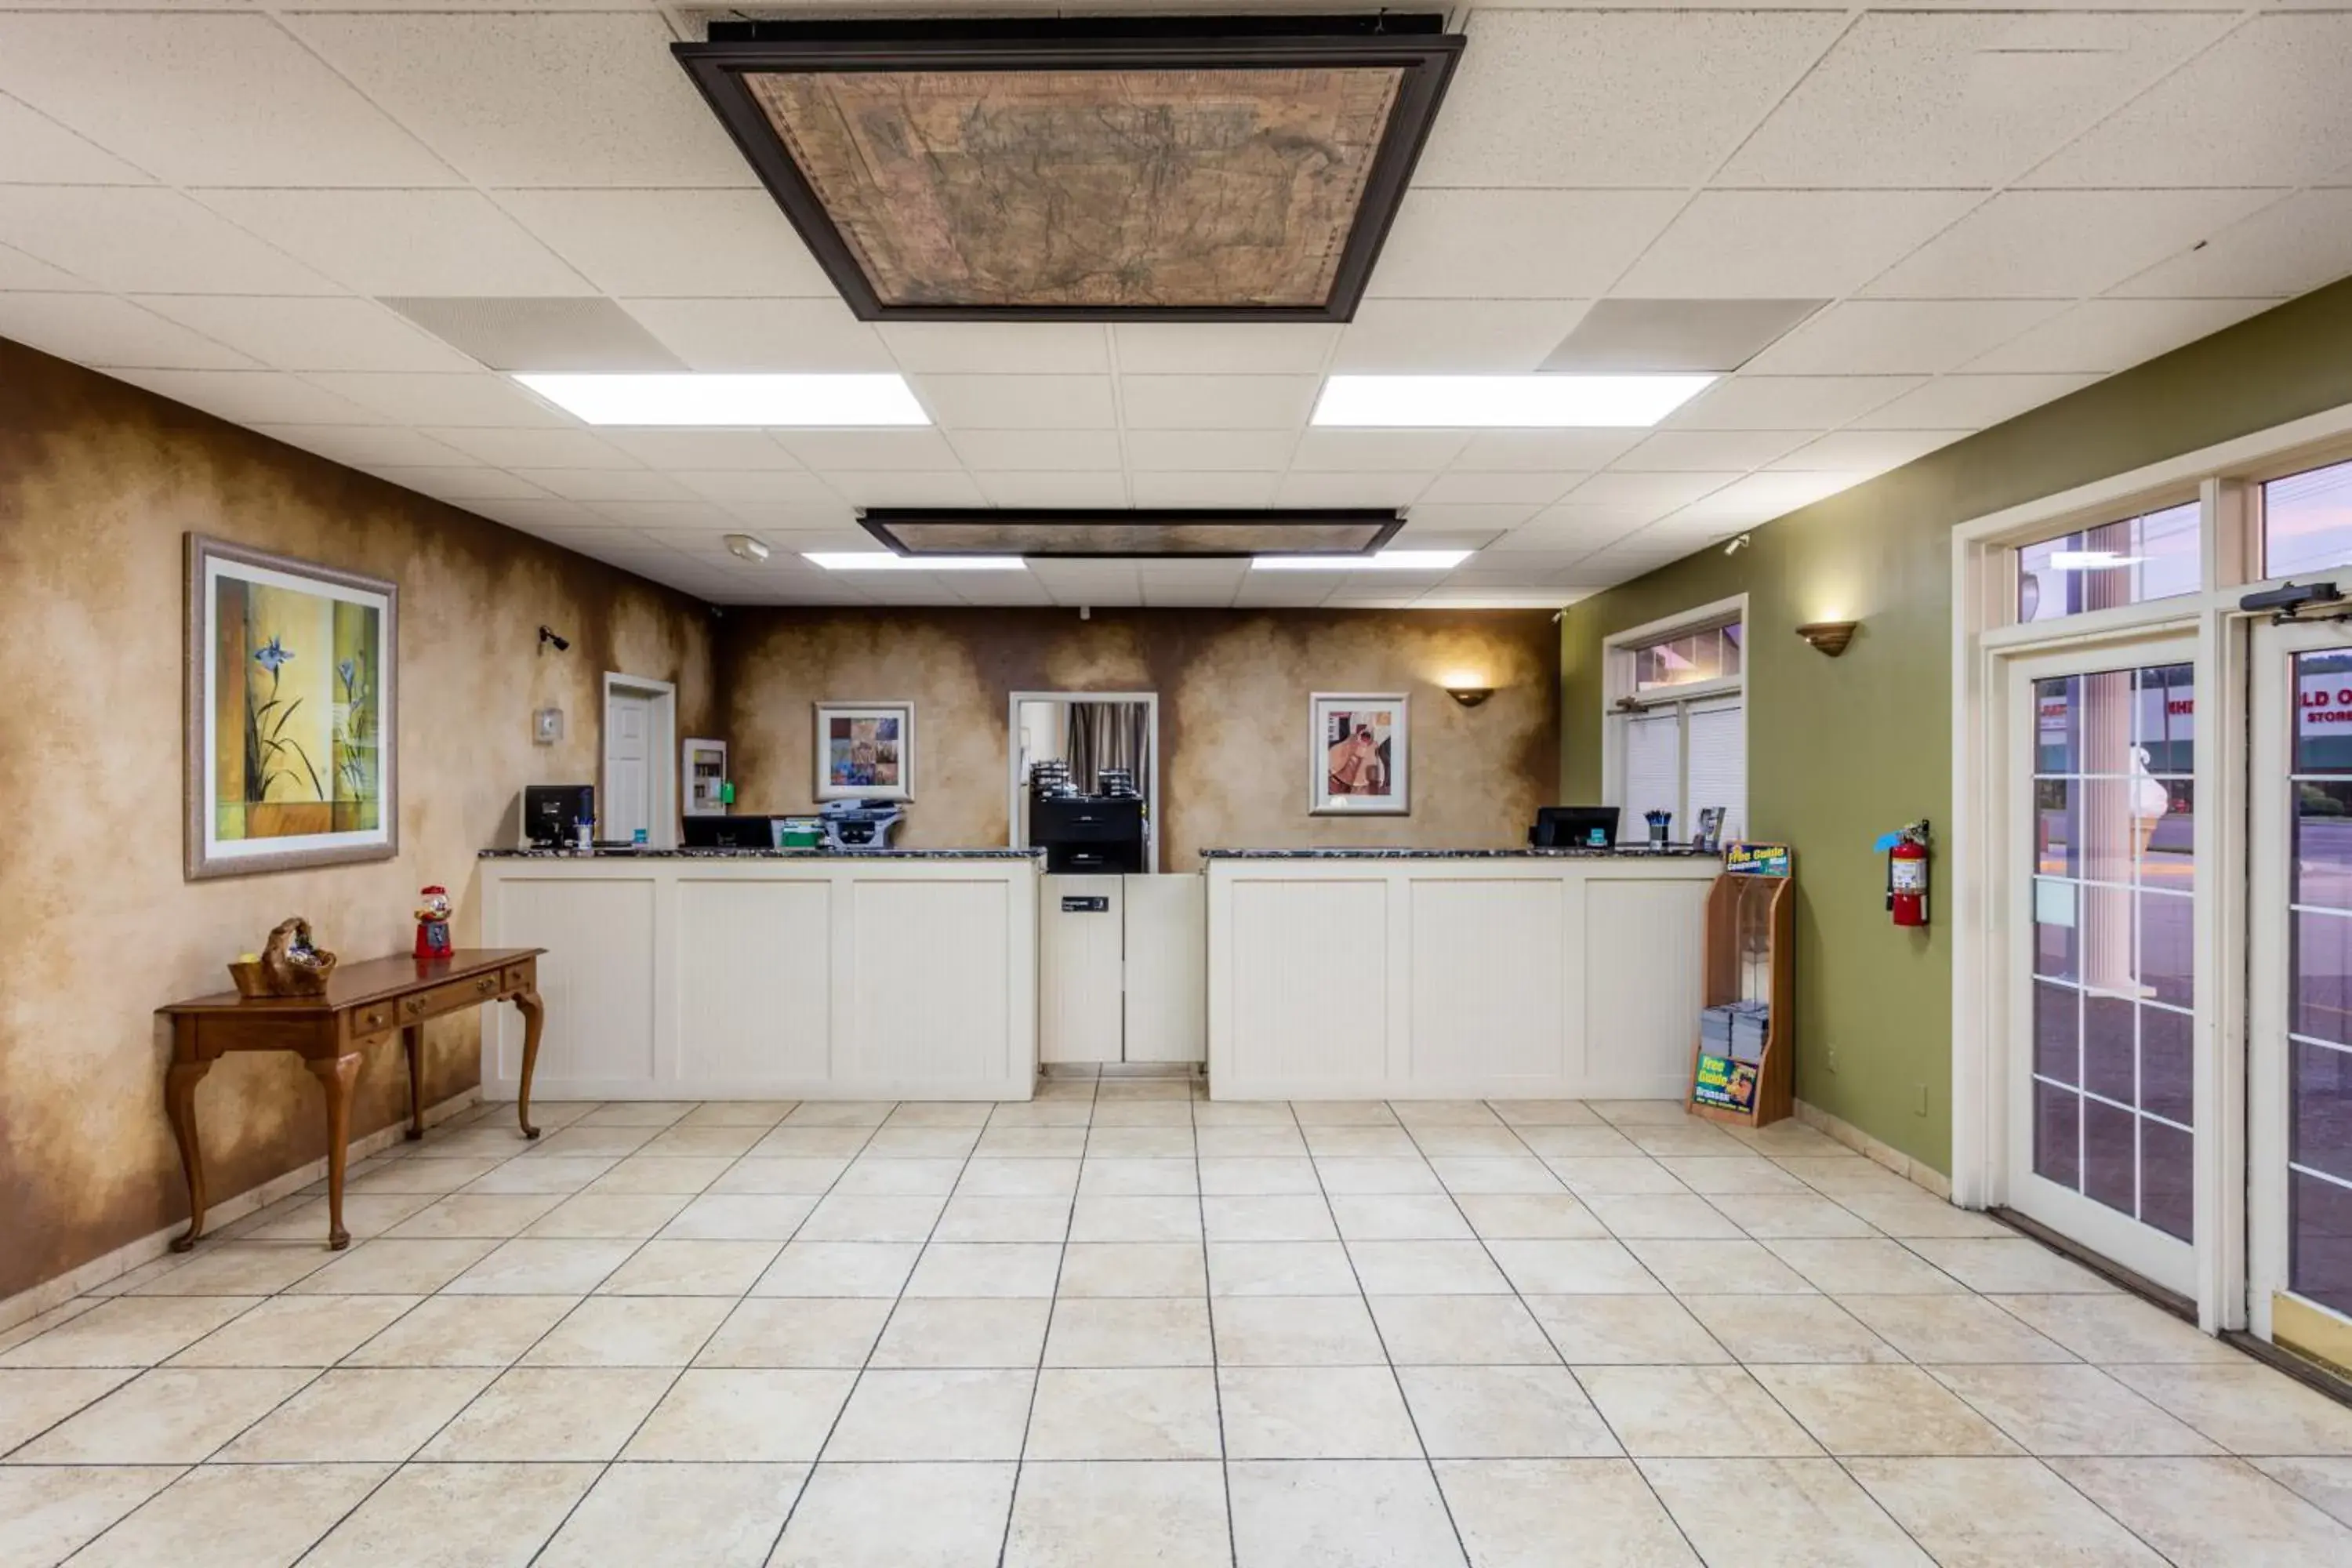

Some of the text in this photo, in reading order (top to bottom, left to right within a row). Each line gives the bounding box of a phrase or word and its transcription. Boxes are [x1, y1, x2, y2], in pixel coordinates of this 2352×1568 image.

[2301, 691, 2329, 706] LD
[1728, 847, 1784, 863] Free Guide
[1703, 1056, 1725, 1072] Free
[1698, 1069, 1728, 1087] Guide
